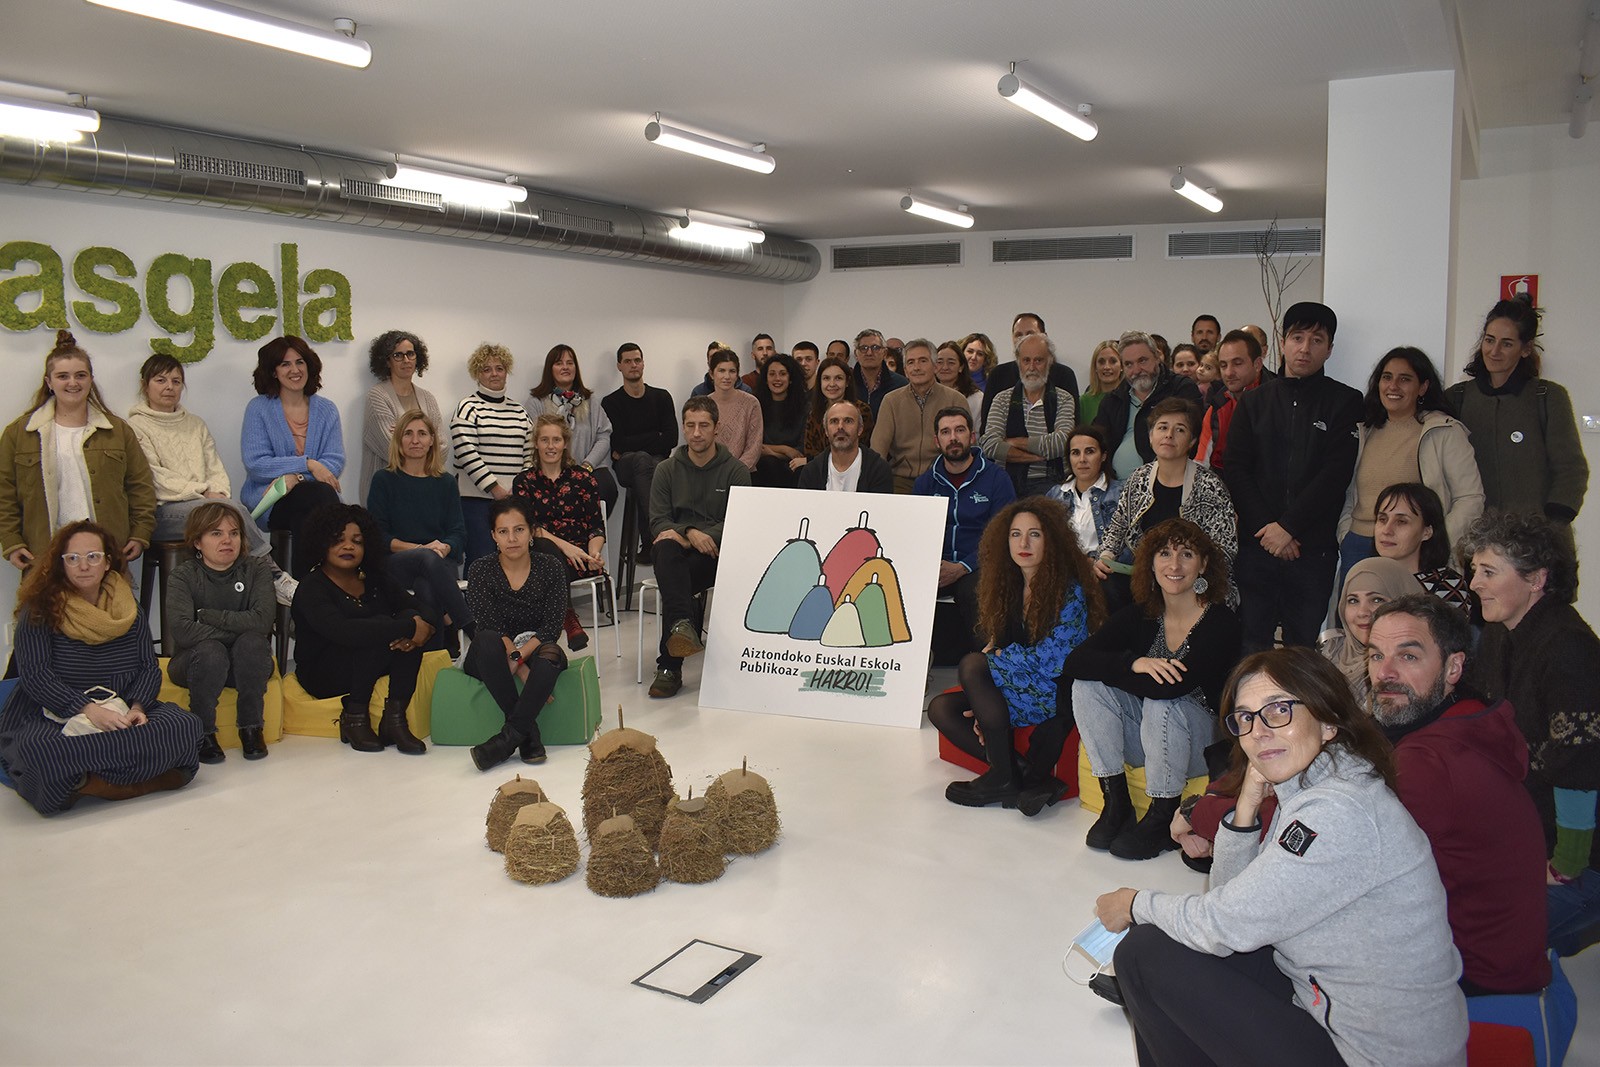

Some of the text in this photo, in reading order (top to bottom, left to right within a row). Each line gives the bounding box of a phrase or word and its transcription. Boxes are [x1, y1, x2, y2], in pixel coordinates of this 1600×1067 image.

[0, 240, 354, 363] asgela
[741, 647, 902, 671] Aiztondoko Euskal Eskola
[739, 660, 873, 693] Publikoaz HARRO!
